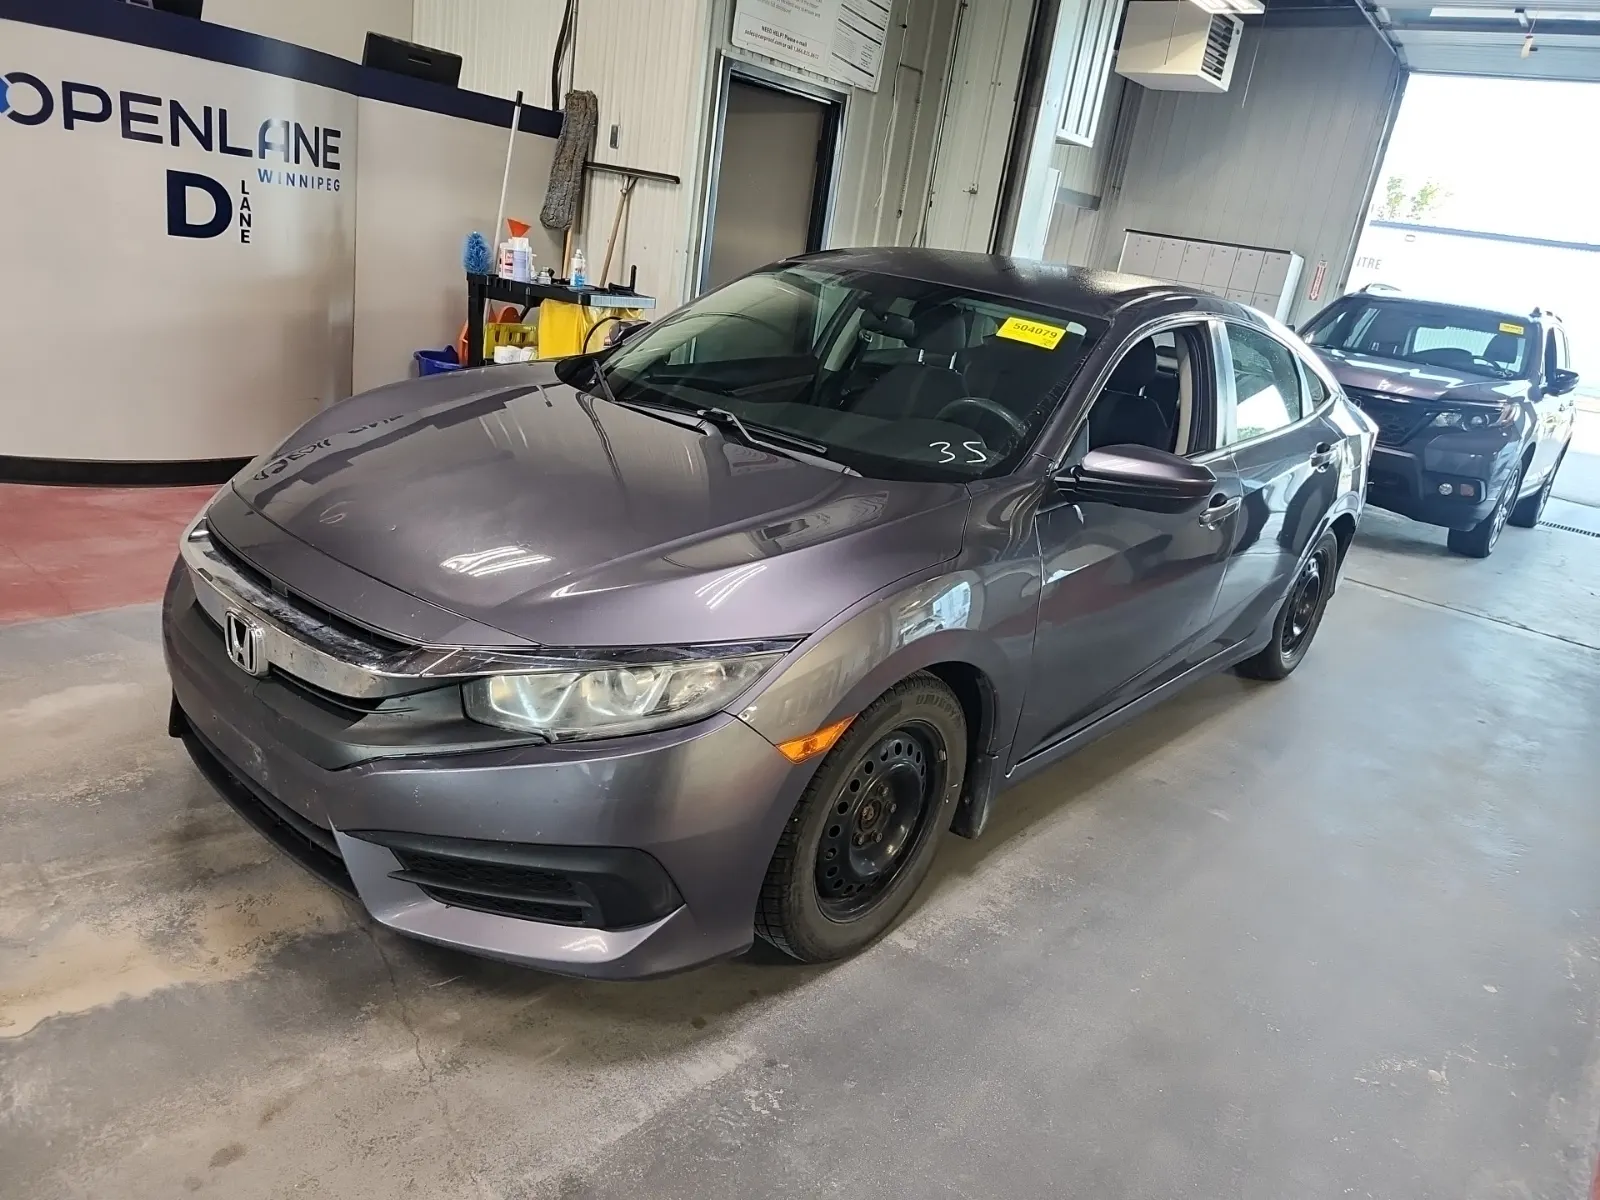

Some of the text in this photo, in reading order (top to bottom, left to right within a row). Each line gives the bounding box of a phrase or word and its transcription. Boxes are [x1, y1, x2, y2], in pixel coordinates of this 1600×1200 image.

[0, 71, 342, 171] OPENLANE
[166, 168, 233, 239] D
[239, 180, 251, 244] LANE
[257, 168, 341, 192] WINNIPEG
[1013, 322, 1058, 339] 504079
